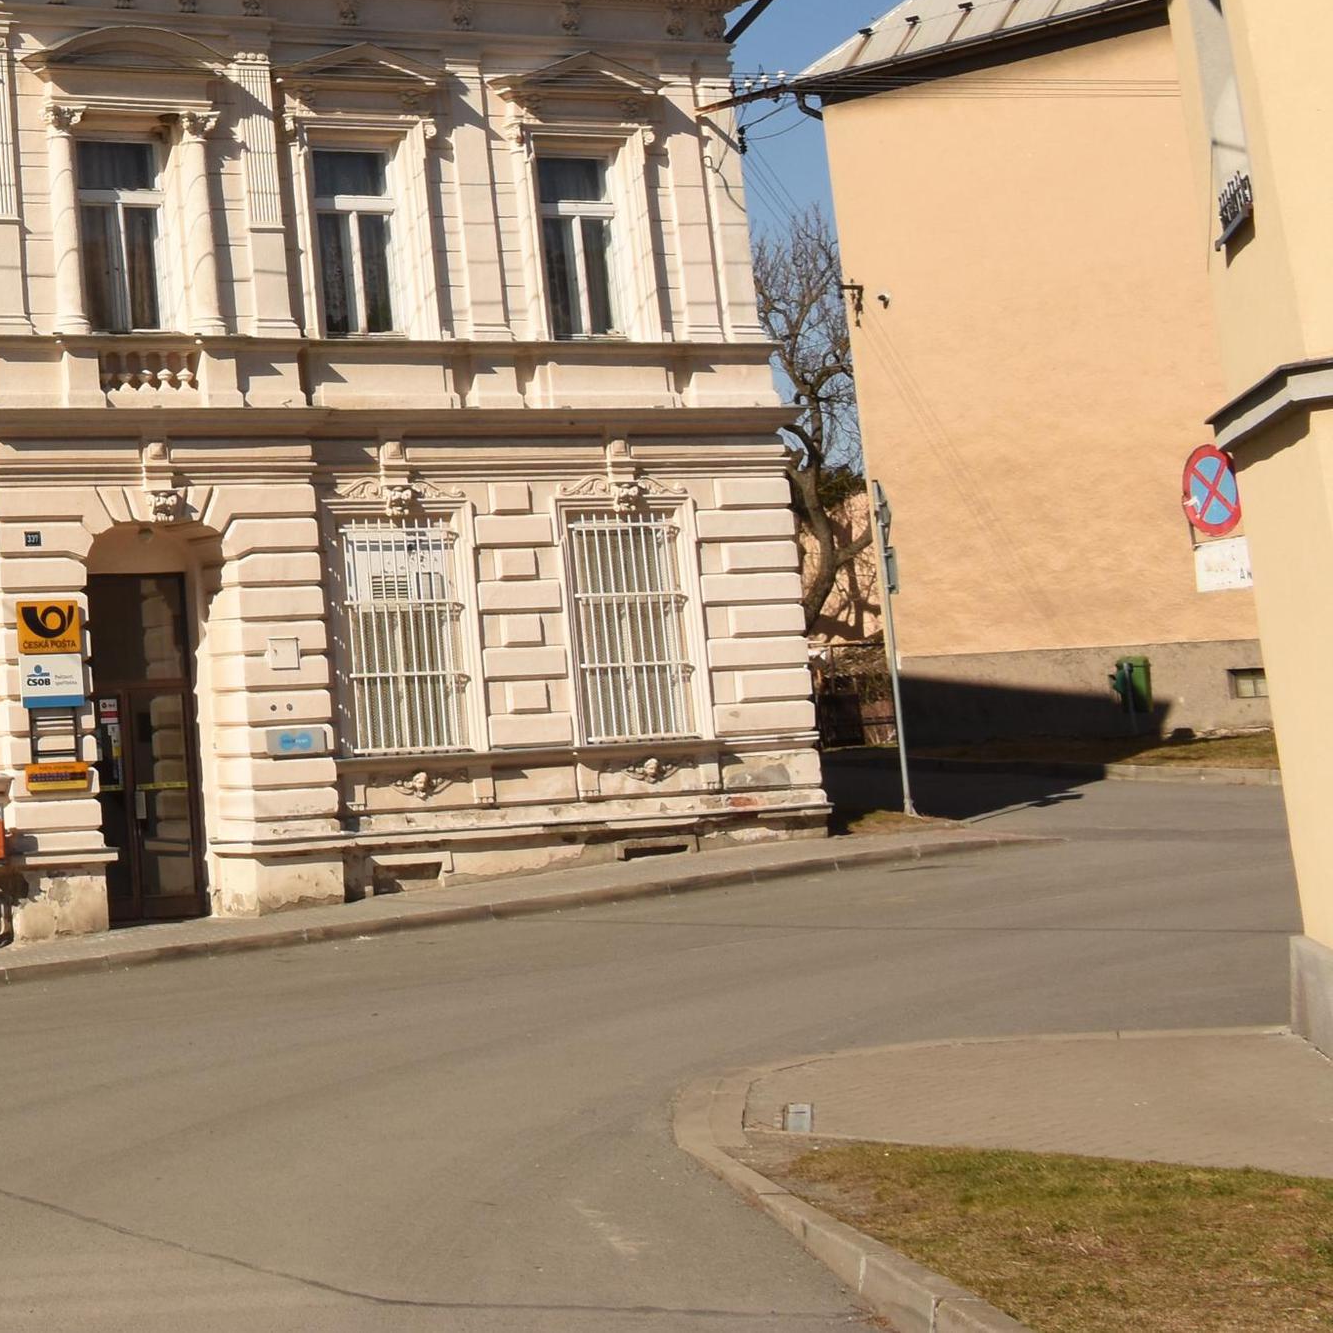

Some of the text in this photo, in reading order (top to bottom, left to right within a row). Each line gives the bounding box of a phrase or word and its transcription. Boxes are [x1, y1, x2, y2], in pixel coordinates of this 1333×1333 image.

[23, 639, 76, 650] ČESKÁ POŠTA
[27, 677, 51, 686] ČSOB
